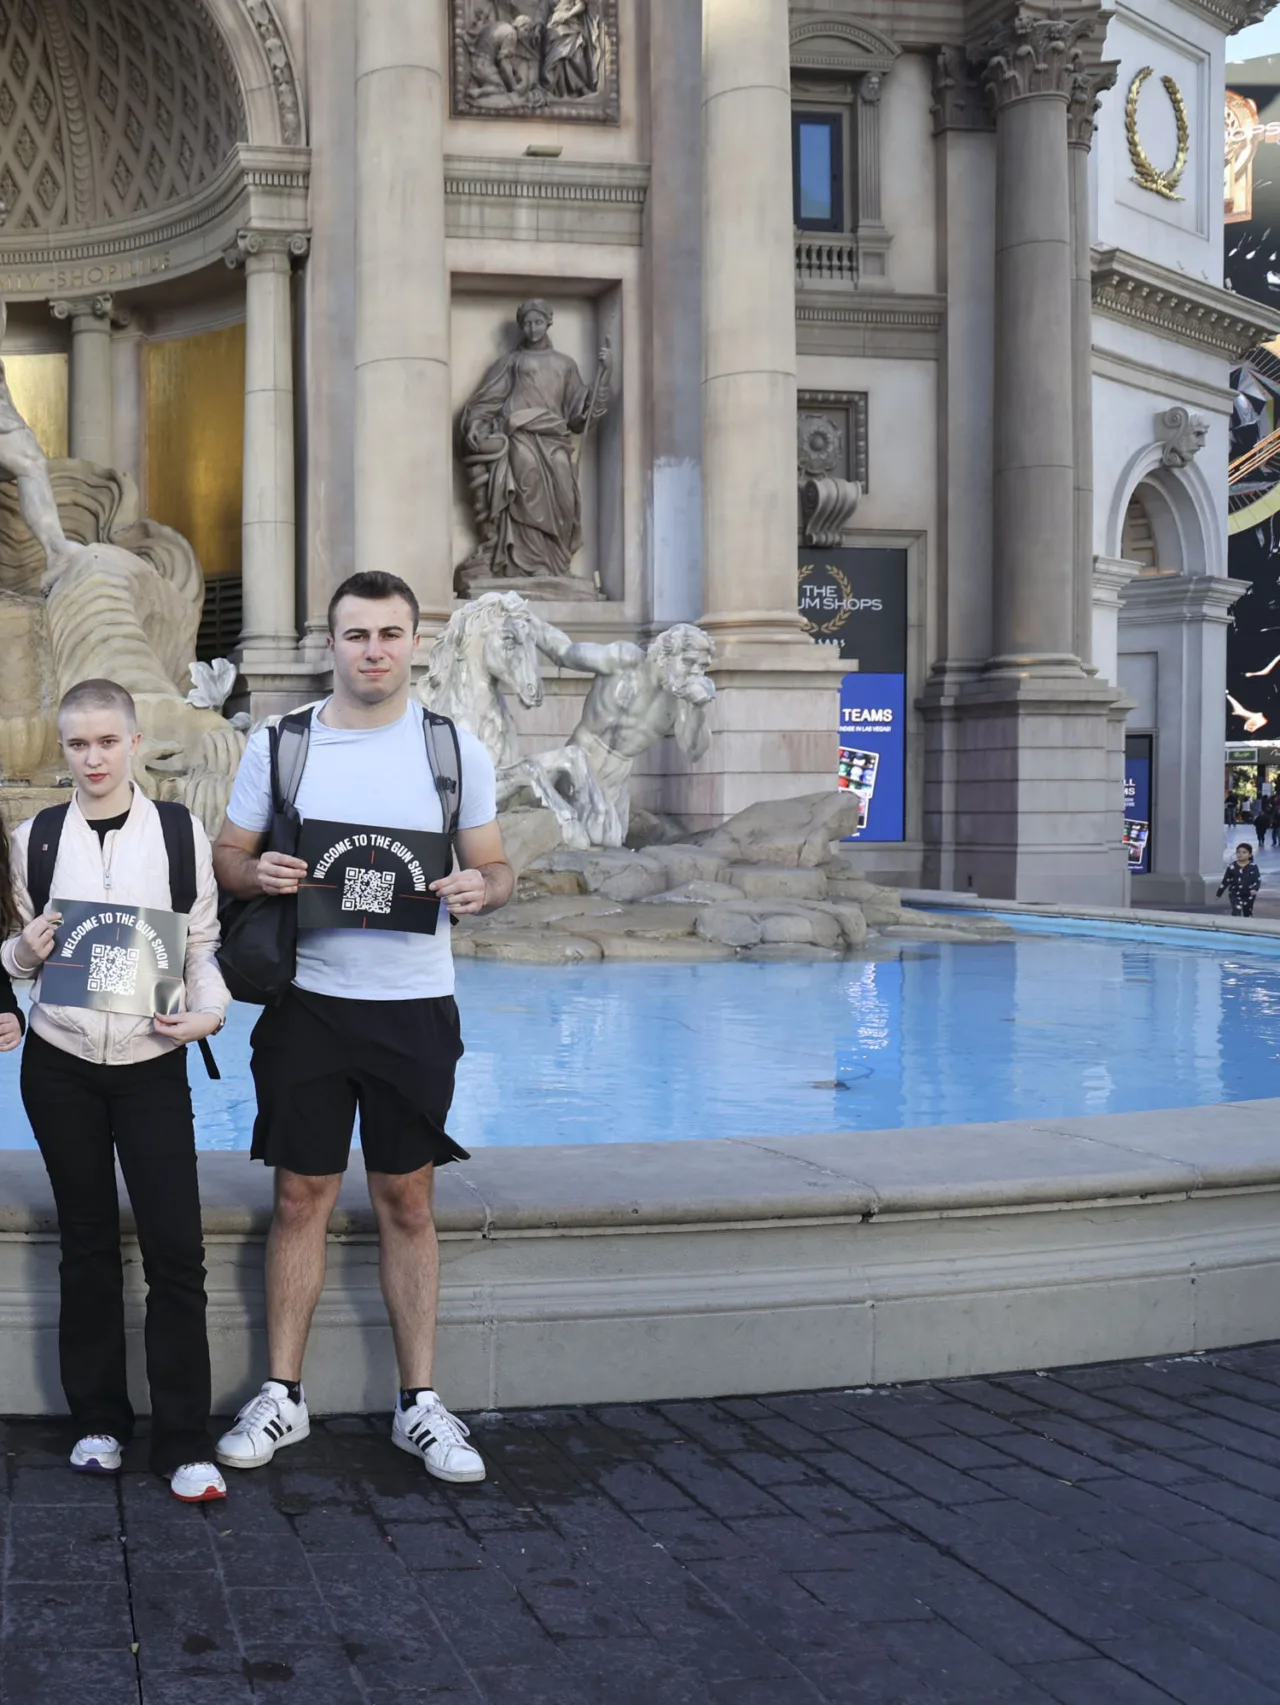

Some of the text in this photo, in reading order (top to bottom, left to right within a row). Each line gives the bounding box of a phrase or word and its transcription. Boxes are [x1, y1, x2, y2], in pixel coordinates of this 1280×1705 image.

[802, 585, 837, 597] THE
[823, 598, 883, 611] SHOPS
[842, 708, 893, 722] TEAMS
[313, 834, 427, 892] WELCOME TO THE GUN SHOW
[61, 912, 169, 970] WELCOME TO THE GUN SHOW
